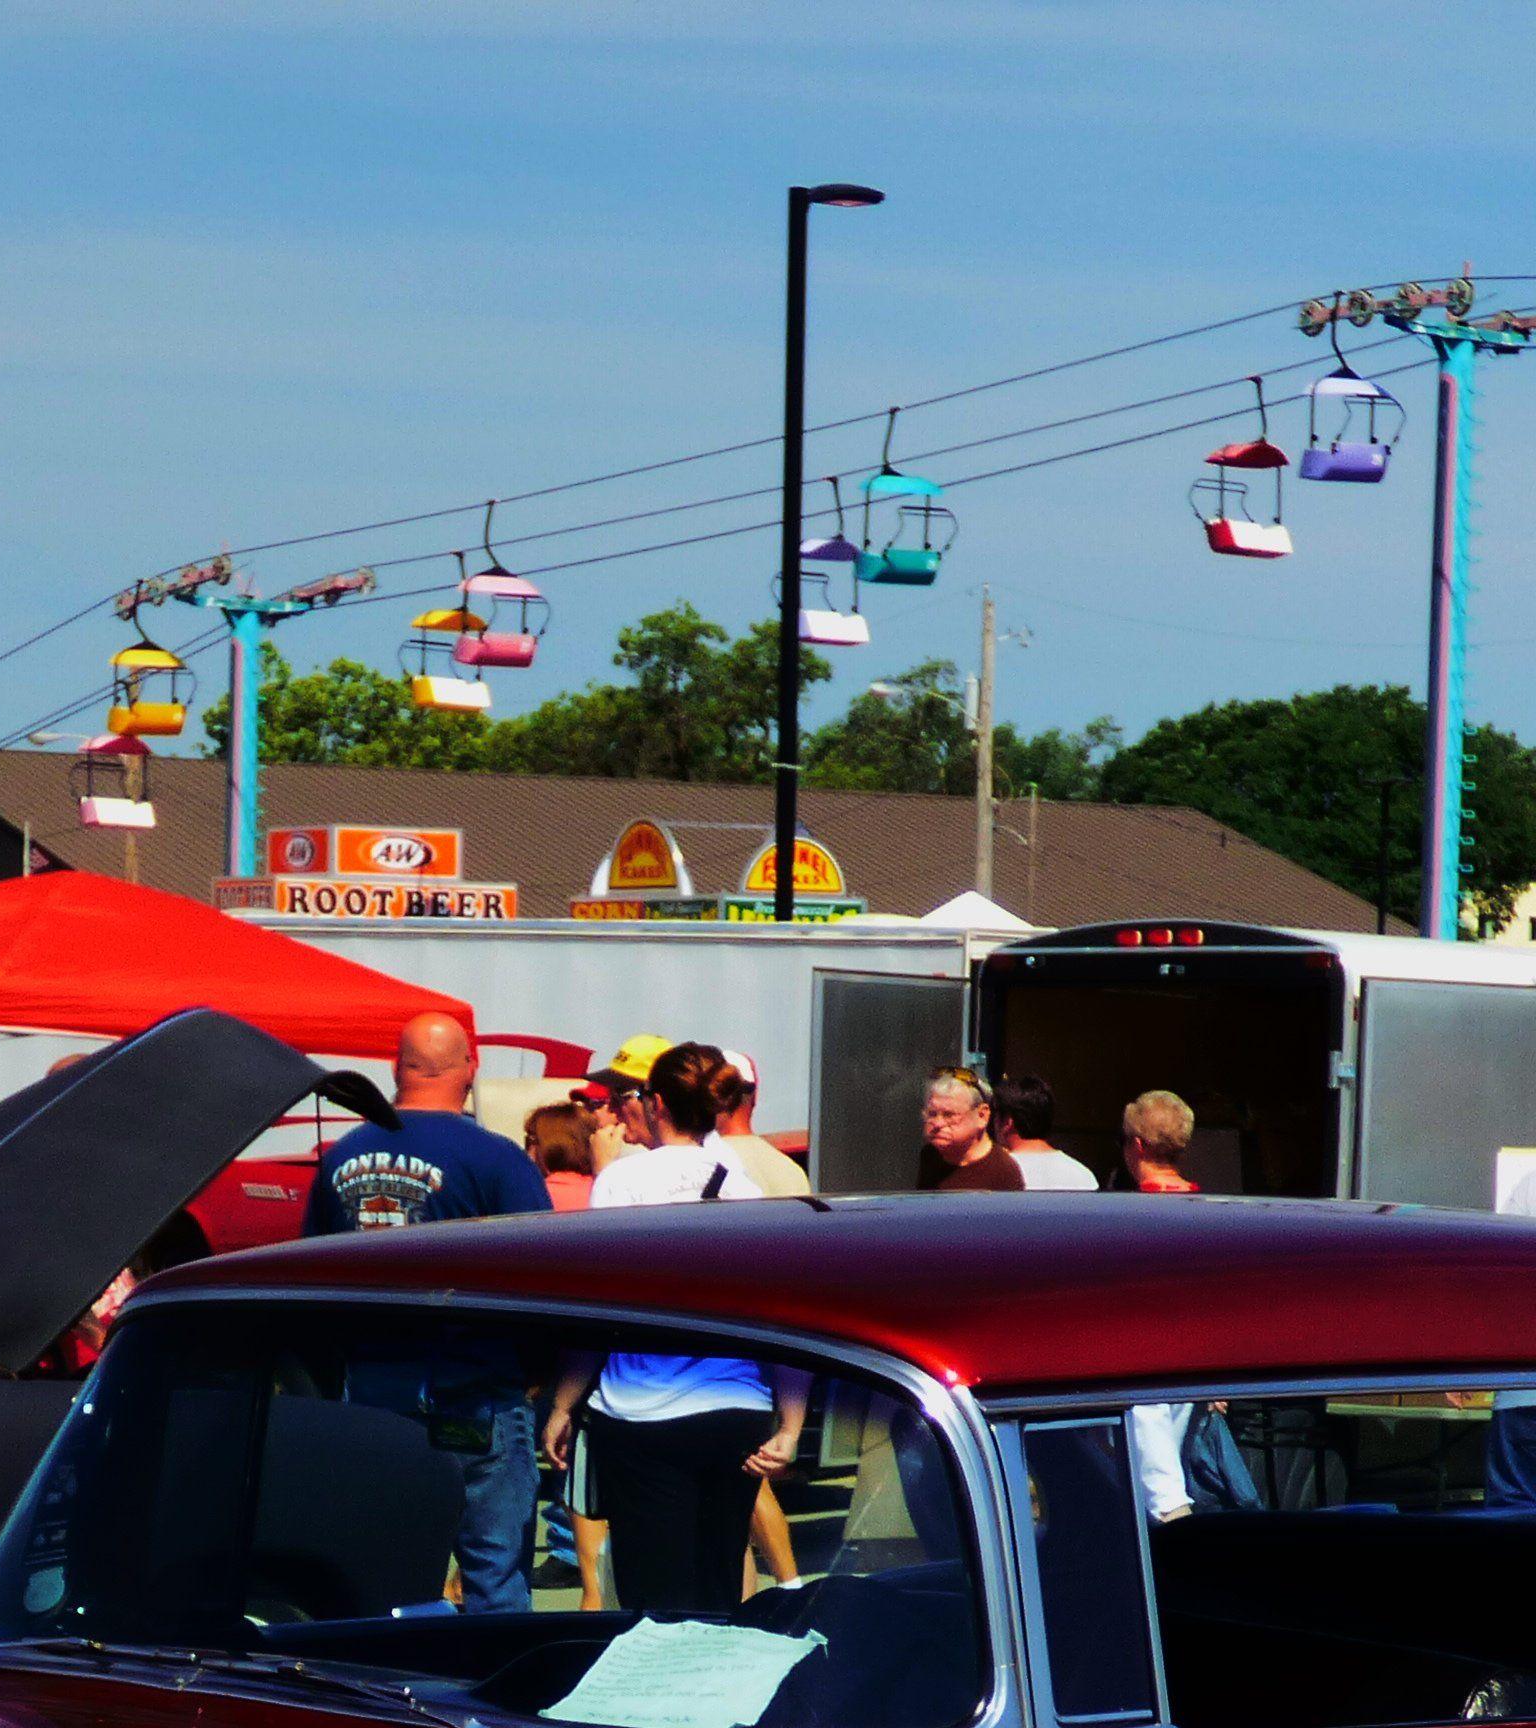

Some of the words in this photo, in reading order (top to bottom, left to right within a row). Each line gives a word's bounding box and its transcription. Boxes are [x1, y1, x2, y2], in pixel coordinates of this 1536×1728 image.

[762, 843, 829, 883] FNEL
[288, 885, 395, 915] ROOT
[404, 889, 505, 919] BEER
